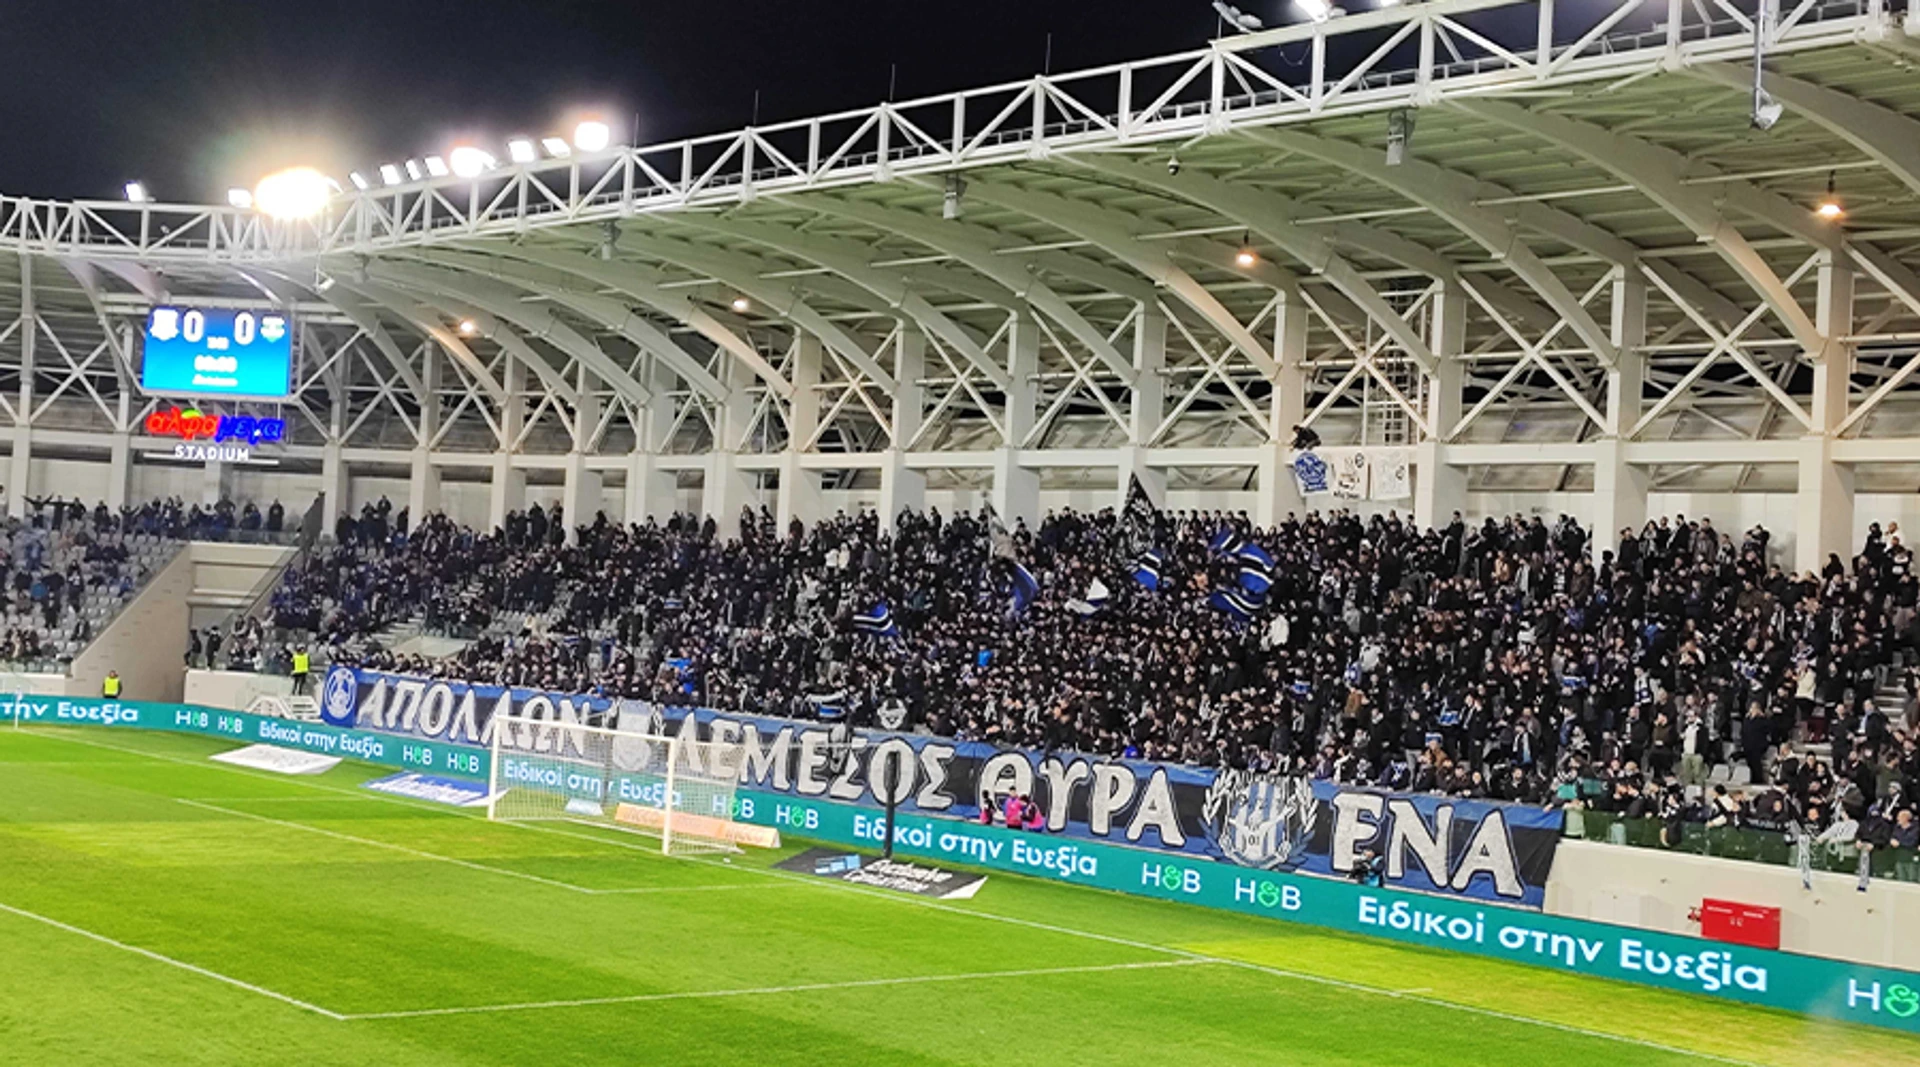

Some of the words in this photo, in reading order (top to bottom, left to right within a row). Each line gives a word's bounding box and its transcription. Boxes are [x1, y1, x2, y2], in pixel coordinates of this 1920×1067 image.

[183, 310, 204, 342] 0
[234, 312, 255, 345] 0
[174, 444, 250, 462] STADIUM
[0, 701, 49, 720] την
[303, 731, 338, 752] στην
[853, 814, 932, 849] Ειδκοί
[939, 832, 1003, 862] στην
[1333, 792, 1524, 897] ΕΝΑ
[1498, 928, 1604, 967] στην
